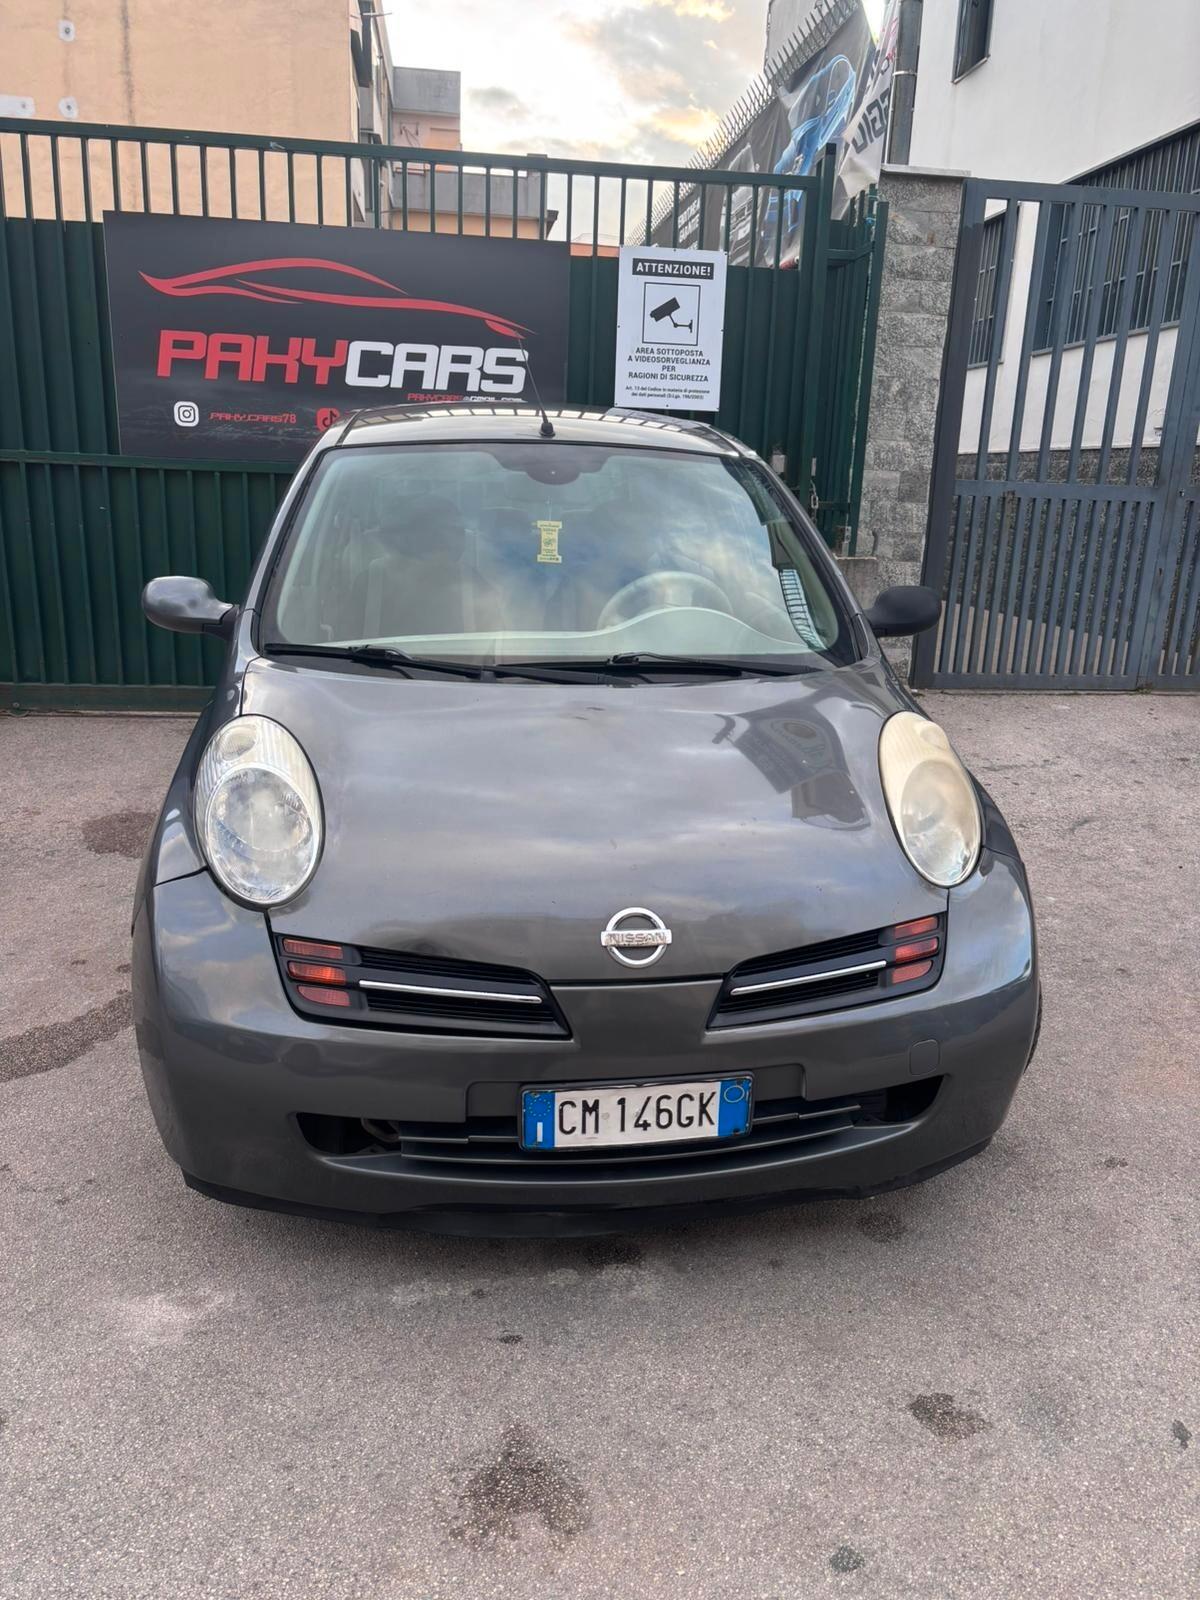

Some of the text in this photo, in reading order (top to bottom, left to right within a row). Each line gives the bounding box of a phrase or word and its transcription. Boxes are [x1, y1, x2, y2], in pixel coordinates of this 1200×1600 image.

[636, 262, 711, 277] ATTENZIONE!
[635, 347, 704, 357] AREA SOTTOPOSTA
[156, 329, 529, 394] PAKYCARS
[634, 355, 711, 366] VIDEOSORVEGLIANZA
[628, 372, 659, 380] RAGIONI
[669, 374, 709, 382] SICUREZZA
[608, 932, 667, 943] NISSAN
[558, 1098, 600, 1135] CM
[617, 1091, 717, 1133] 146GK
